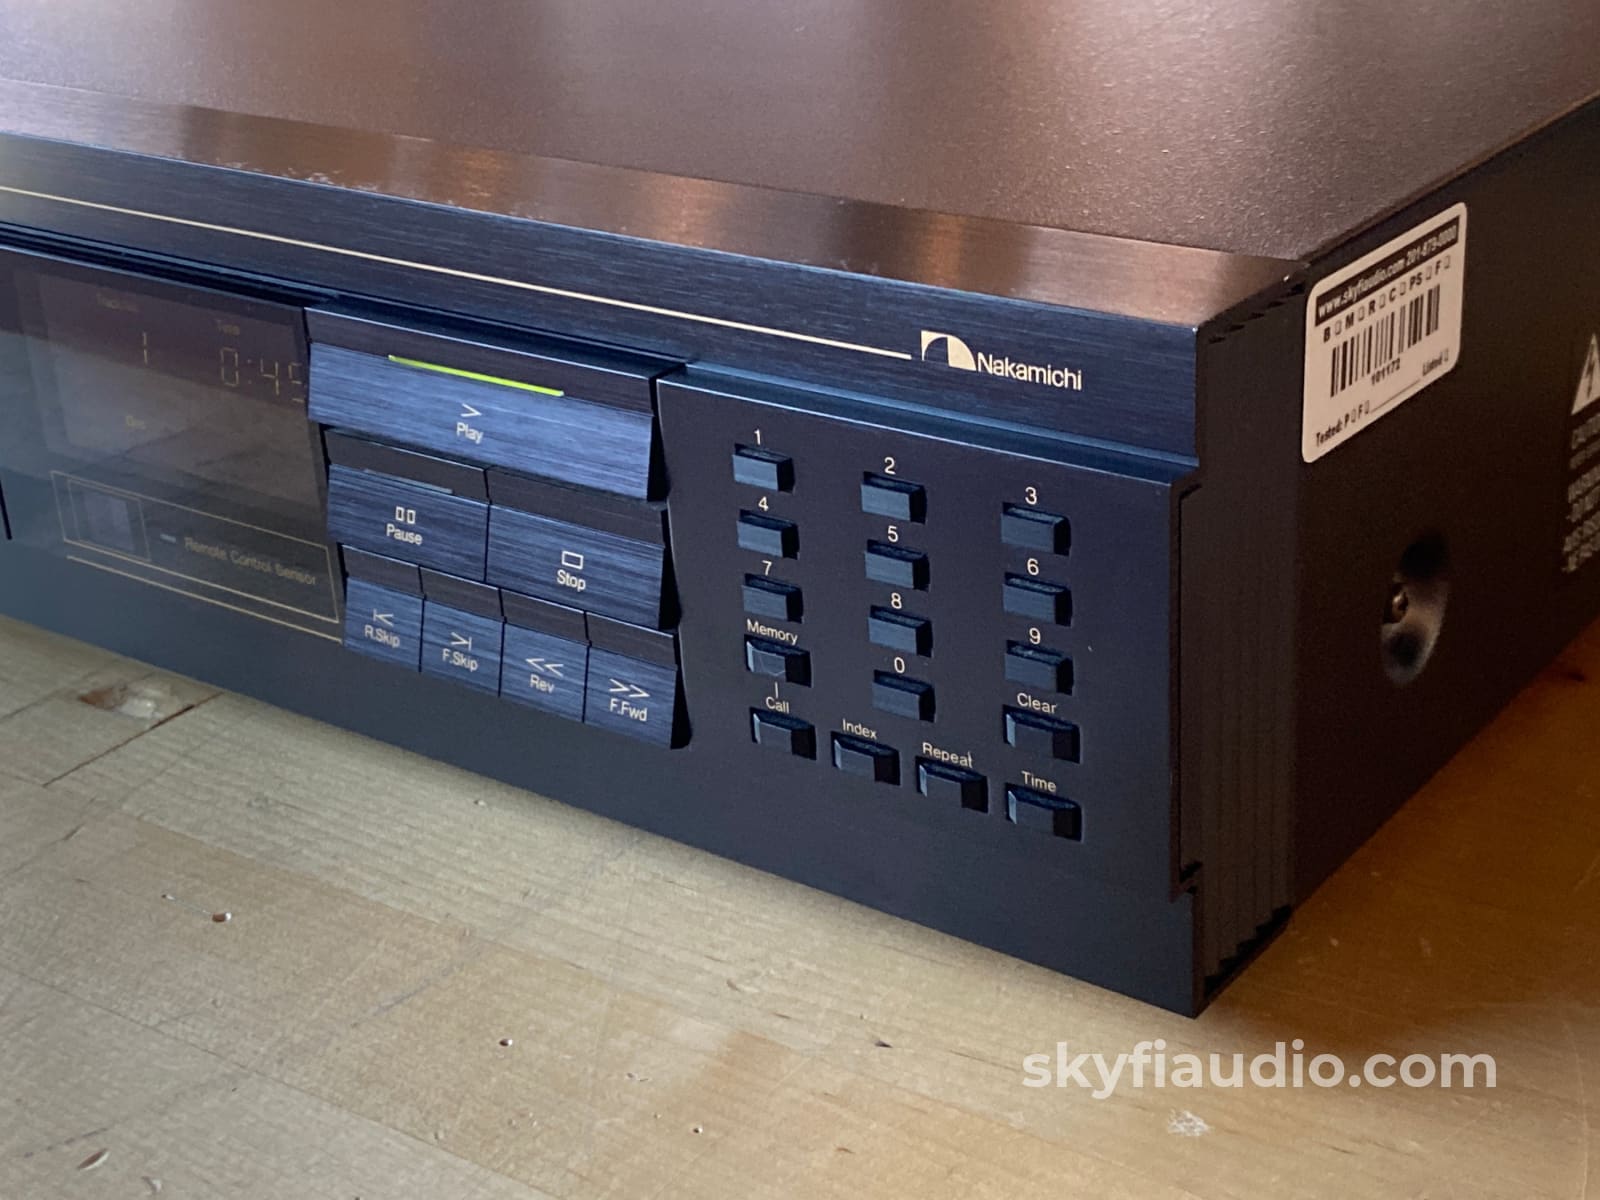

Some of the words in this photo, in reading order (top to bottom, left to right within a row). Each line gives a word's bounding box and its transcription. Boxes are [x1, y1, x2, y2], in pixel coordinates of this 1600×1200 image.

[1317, 257, 1406, 318] www.skyfiaudio.com
[1323, 325, 1331, 343] B
[1345, 312, 1355, 329] M
[1368, 299, 1376, 315] R
[1389, 287, 1398, 302] C
[1409, 271, 1423, 290] PS
[1435, 260, 1442, 276] F
[977, 352, 1083, 391] Nakamichi
[456, 421, 484, 444] Play
[753, 429, 762, 445] 1
[1316, 418, 1343, 447] Tested:
[884, 457, 896, 474] 2
[757, 496, 769, 511] 4
[1024, 487, 1038, 504] 3
[386, 525, 423, 546] Pause
[887, 526, 899, 542] 5
[184, 537, 228, 560] Remote
[229, 547, 273, 573] Control
[274, 563, 317, 585] Sensor
[761, 561, 773, 576] 7
[1026, 558, 1039, 575] 6
[556, 569, 587, 592] Stop
[890, 592, 902, 609] 8
[364, 624, 401, 648] R.Skip
[746, 618, 799, 645] Memory
[1028, 627, 1041, 644] 9
[442, 648, 478, 672] F.Skip
[894, 657, 906, 674] 0
[529, 674, 555, 693] Rev
[609, 698, 648, 723] F.Fwd
[765, 696, 790, 714] Call
[1017, 693, 1057, 714] Clear
[841, 719, 878, 740] Index
[922, 742, 973, 768] Repeat
[1022, 771, 1057, 793] Time
